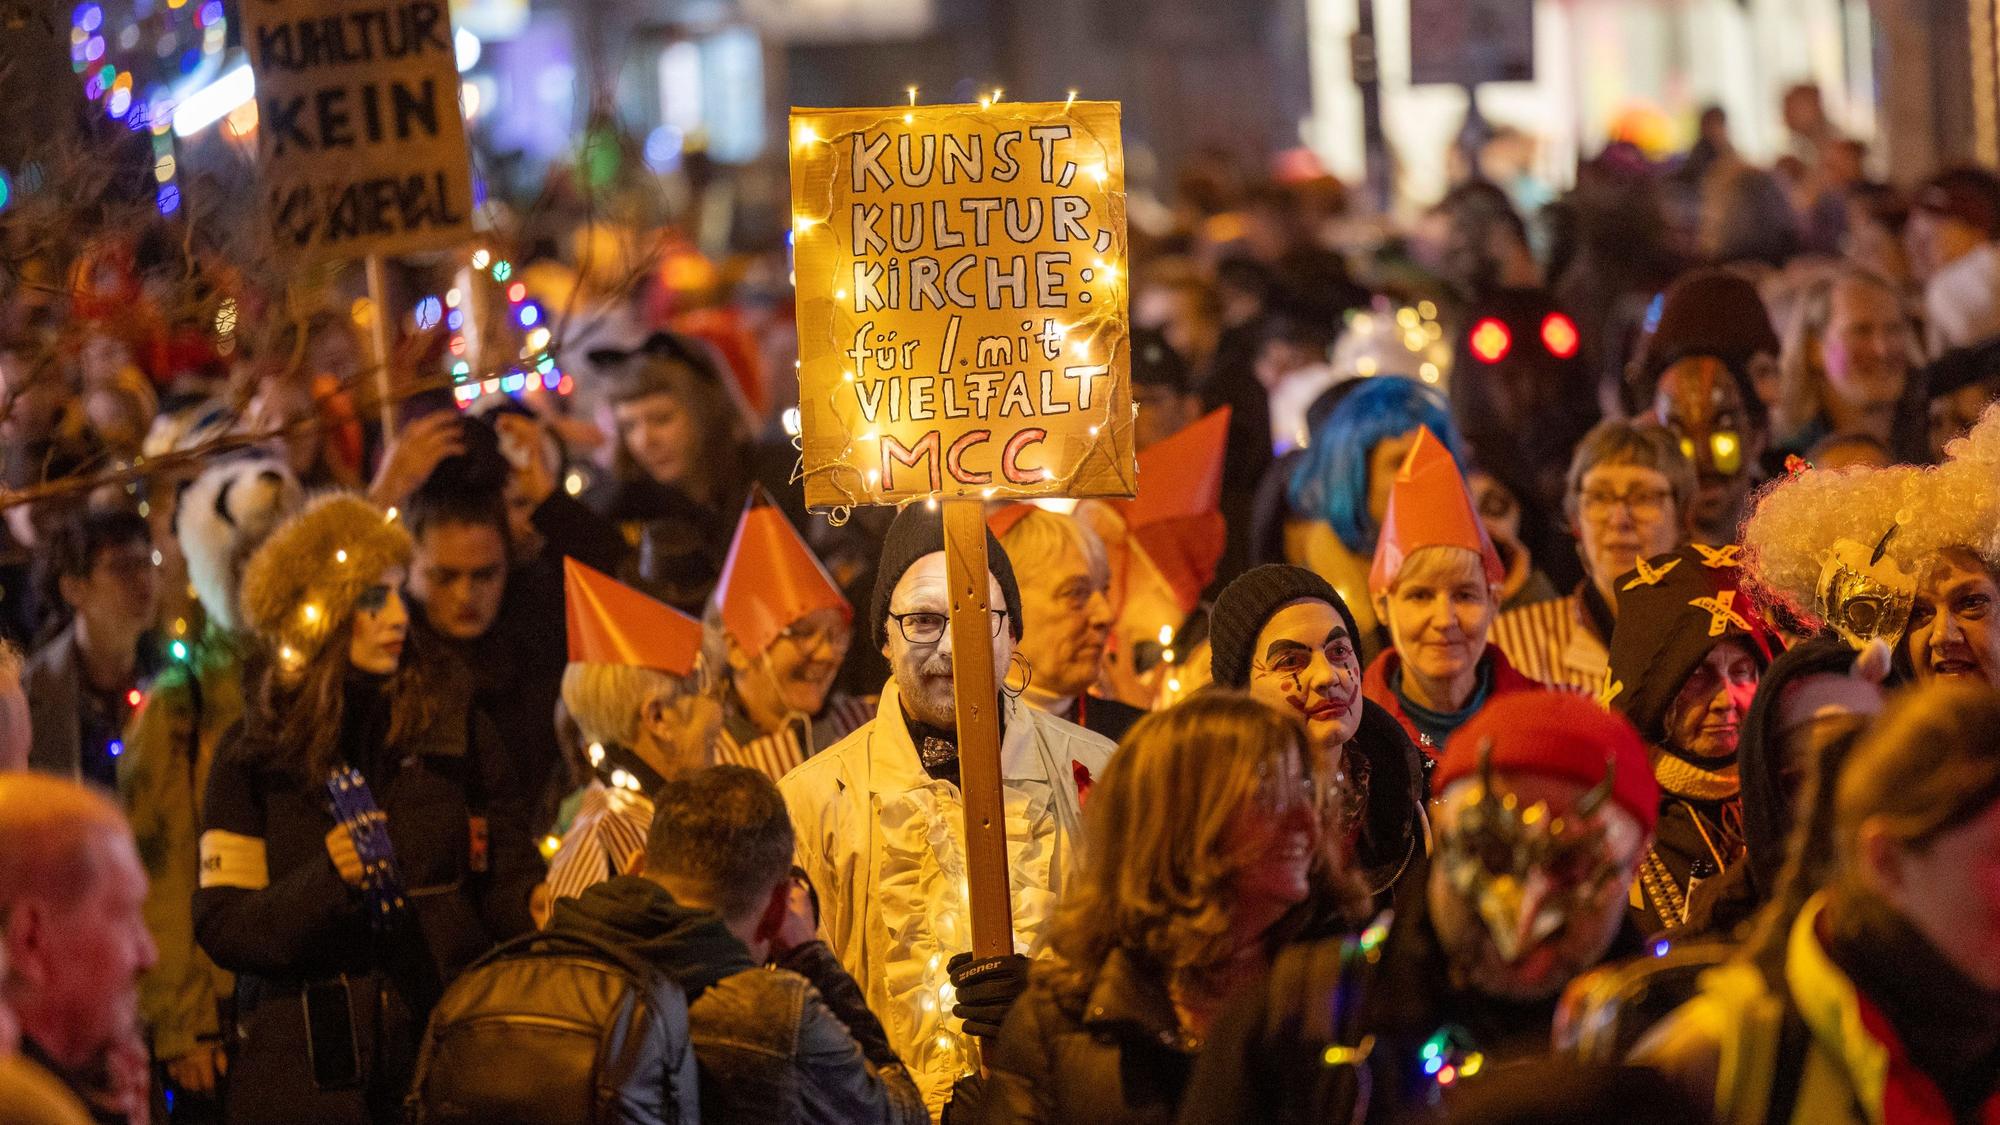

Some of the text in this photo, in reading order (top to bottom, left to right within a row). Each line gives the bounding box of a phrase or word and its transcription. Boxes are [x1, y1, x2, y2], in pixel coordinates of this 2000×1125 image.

[268, 79, 438, 154] KEIN
[852, 125, 1077, 193] KUNST,
[852, 196, 1111, 257] KULTUR,
[846, 322, 920, 377] für
[976, 319, 1064, 367] mit
[854, 366, 1110, 423] VIELFALT
[880, 427, 1048, 492] MCC
[958, 961, 1002, 981] ziener
